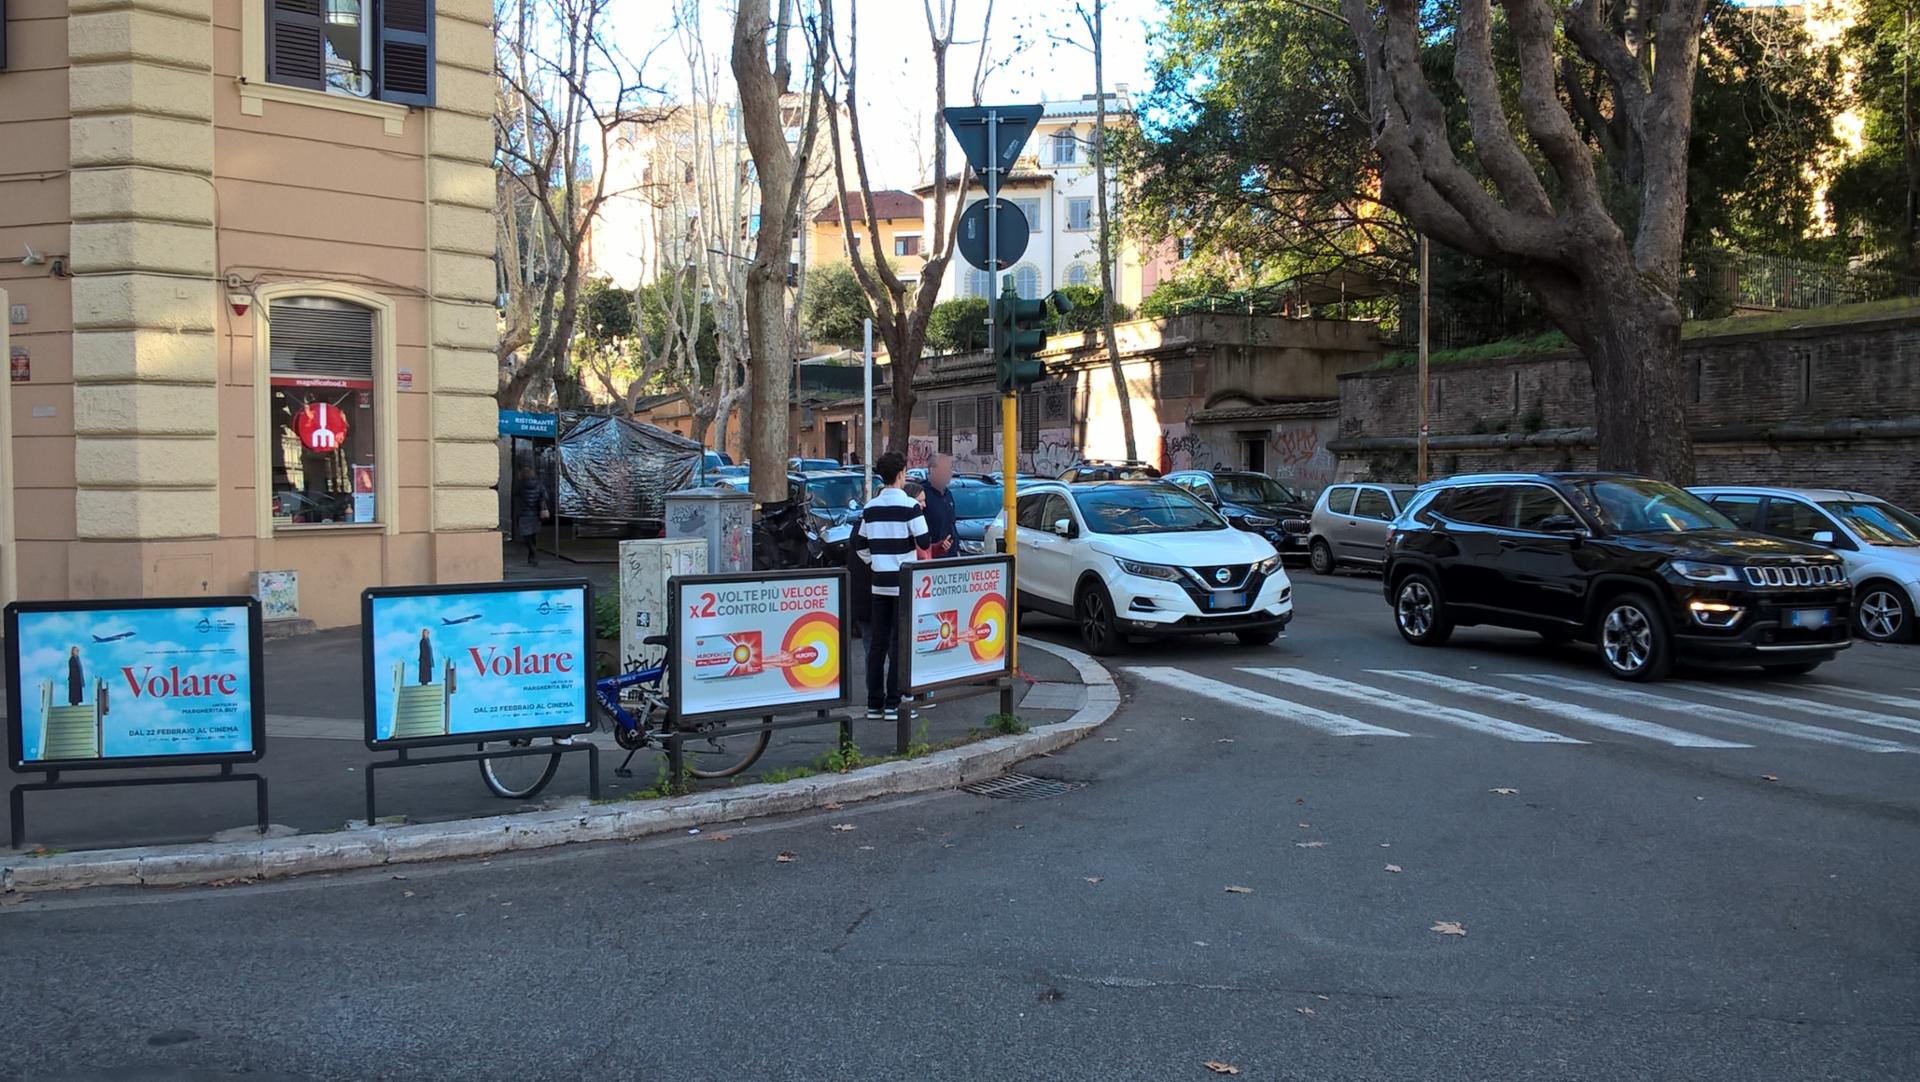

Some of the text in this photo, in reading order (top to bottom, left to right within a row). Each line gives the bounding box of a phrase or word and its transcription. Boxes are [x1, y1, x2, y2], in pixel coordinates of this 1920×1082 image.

[514, 417, 554, 426] RISTORANTE
[932, 574, 958, 585] VOLTE
[971, 570, 1000, 580] VELOCE
[717, 590, 758, 602] VOLTE
[761, 586, 780, 600] PIÙ
[782, 585, 828, 598] VELOCE
[932, 585, 962, 596] CONTRO
[963, 585, 968, 593] IL
[717, 602, 767, 616] CONTRO
[769, 602, 778, 612] IL
[468, 646, 573, 677] Volare
[121, 666, 237, 698] Volare
[473, 706, 488, 714] DAL
[129, 729, 144, 737] DAL
[156, 727, 195, 735] FEBBRAIO
[197, 726, 208, 734] AL
